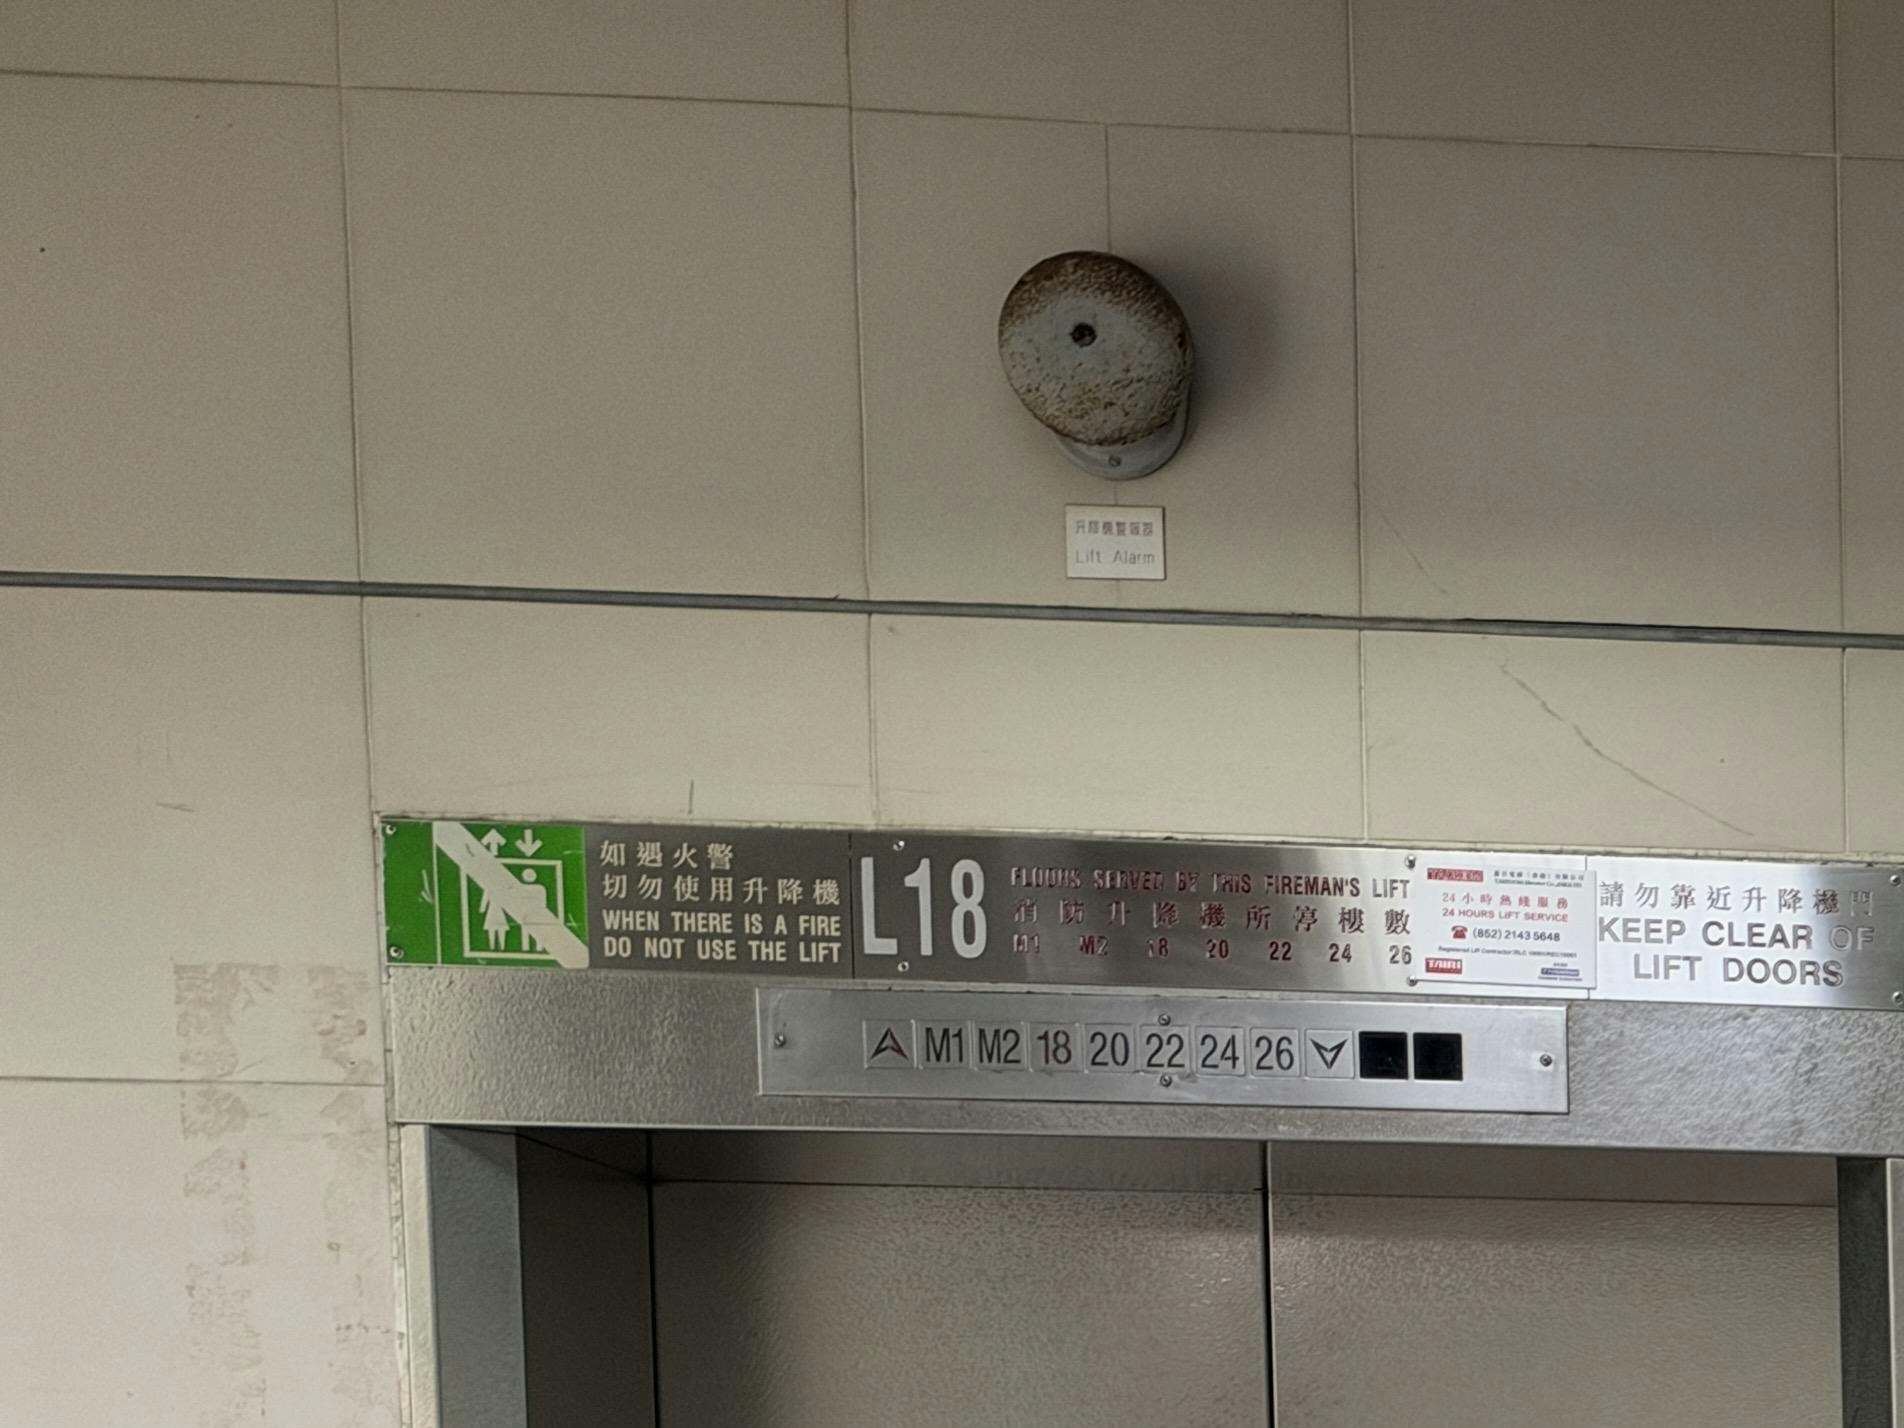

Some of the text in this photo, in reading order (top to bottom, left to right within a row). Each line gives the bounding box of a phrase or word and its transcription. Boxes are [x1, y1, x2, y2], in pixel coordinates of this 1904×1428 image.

[1075, 549, 1155, 564] Lift Alarm
[600, 840, 733, 870] 如遇火警
[602, 873, 840, 905] 切勿使用升降機
[1011, 867, 1410, 898] FLOORS SERVED BY THIS FIREMAN'S LIFT
[861, 856, 987, 959] L18
[1600, 881, 1873, 916] 請勿靠近升降機門
[602, 910, 841, 936] WHEN THERE IS A FIRE
[1013, 898, 1411, 935] 消防升降機所停樓數
[1442, 908, 1568, 922] 24 HOURS LIFT SERVICE
[1473, 927, 1560, 942] (852) 2143 5648
[1599, 917, 1875, 950] KEEP CLEAR OF
[604, 936, 841, 963] DO NOT USE THE LIFT
[1634, 954, 1844, 987] LIFT DOORS
[925, 1027, 1295, 1071] M1 M2 18 20 22 24 26
